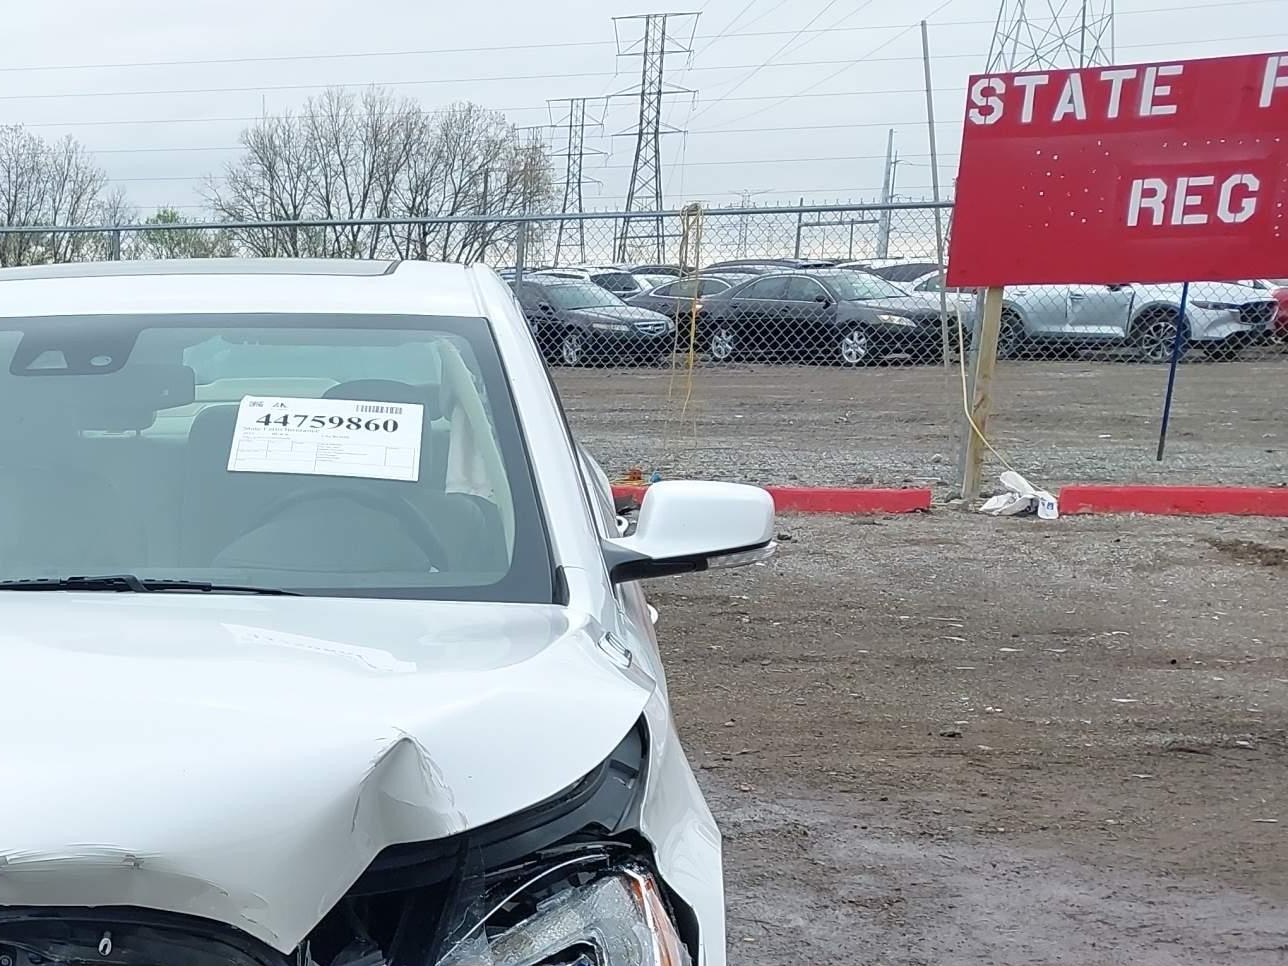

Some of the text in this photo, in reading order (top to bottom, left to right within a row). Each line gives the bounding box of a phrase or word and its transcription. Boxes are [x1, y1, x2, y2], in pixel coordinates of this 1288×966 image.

[968, 64, 1184, 125] STATE
[1127, 173, 1260, 227] REG
[255, 413, 399, 433] 44759860
